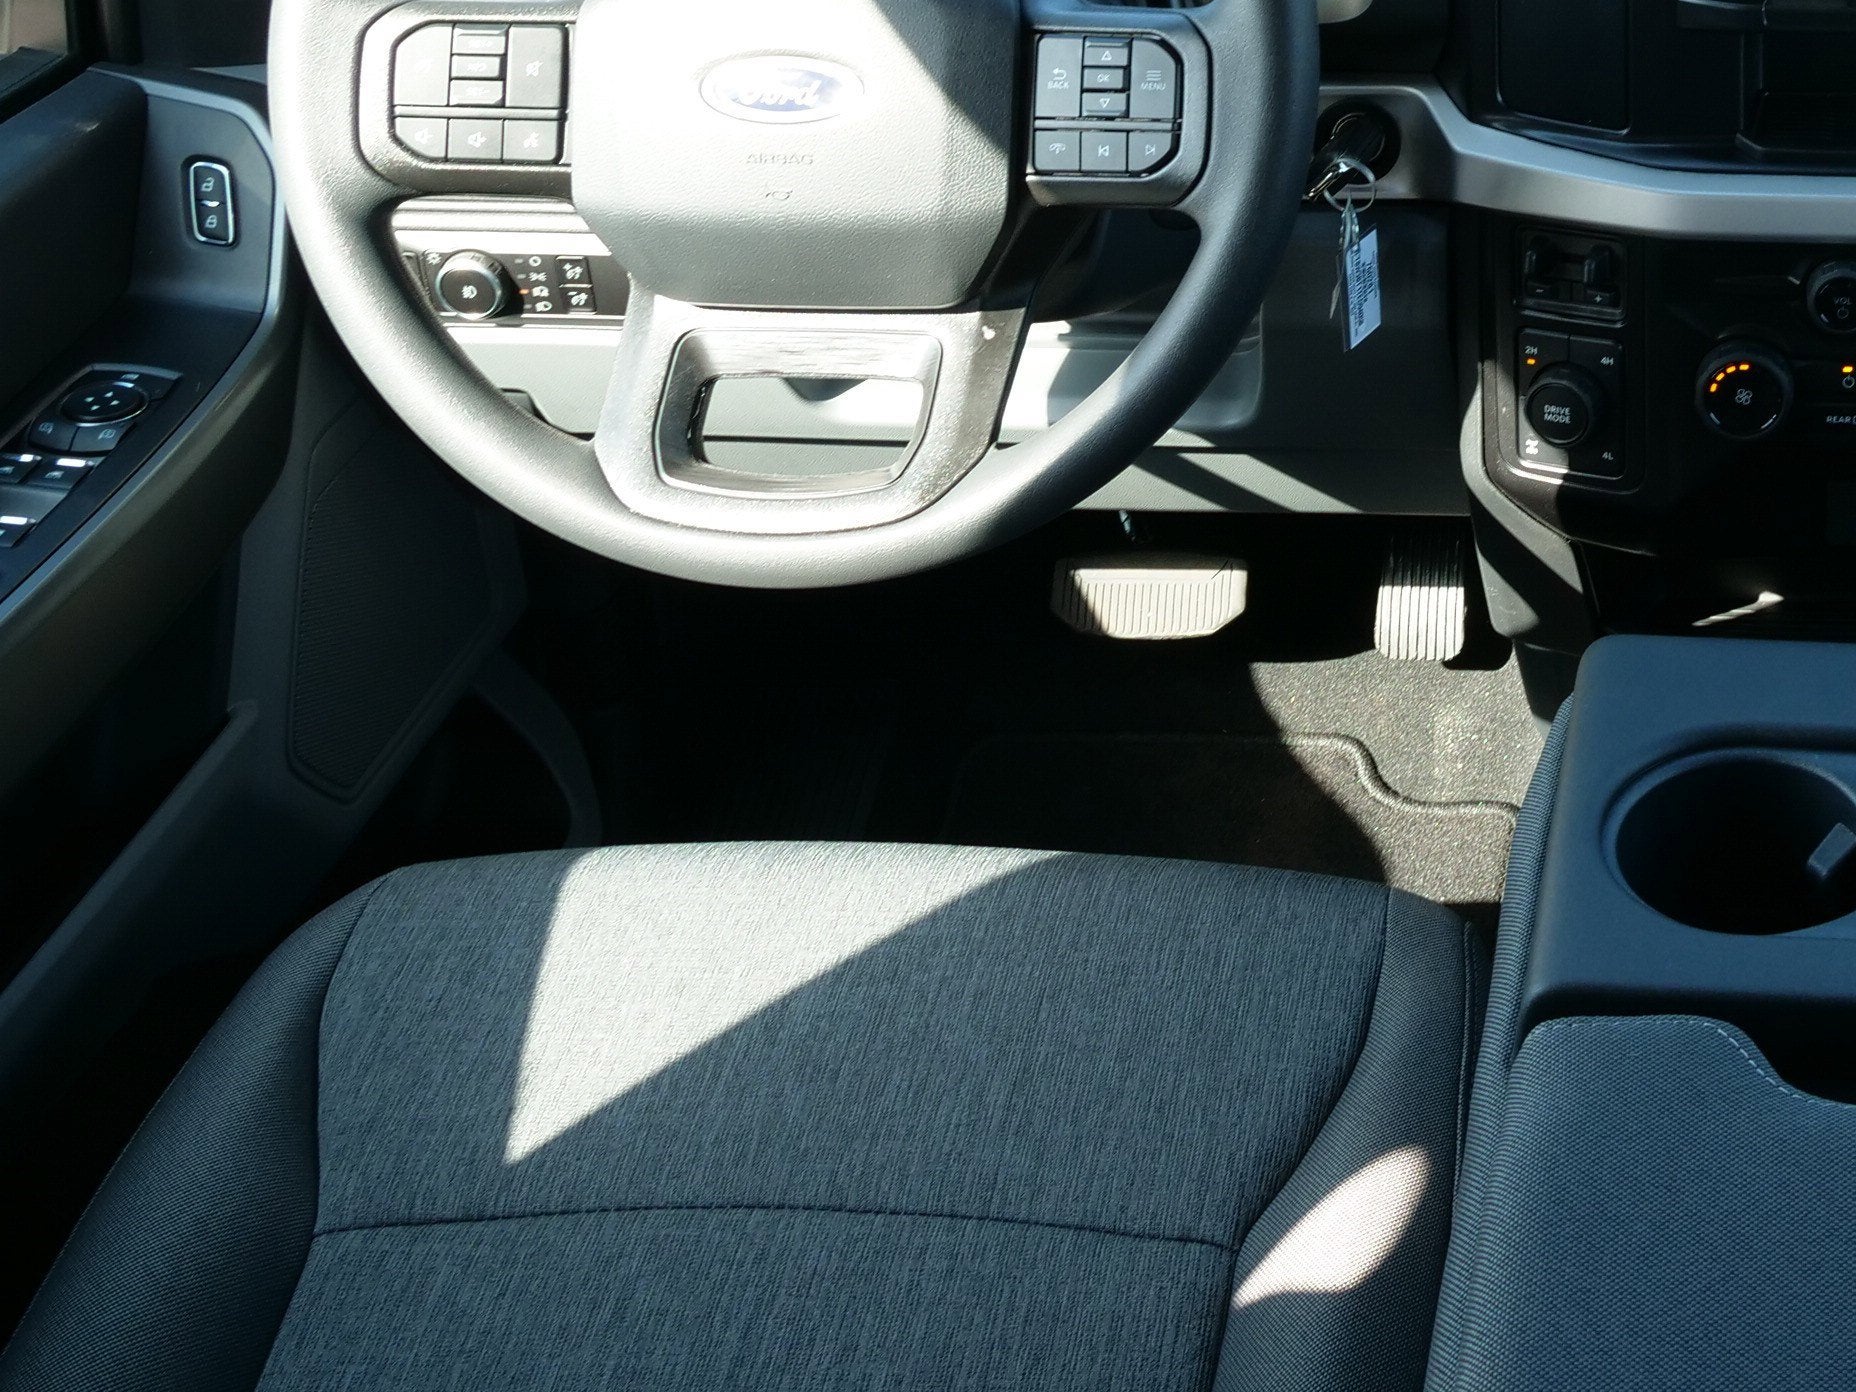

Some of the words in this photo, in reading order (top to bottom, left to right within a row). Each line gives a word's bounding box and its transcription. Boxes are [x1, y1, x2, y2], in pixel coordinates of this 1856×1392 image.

[1046, 80, 1070, 90] BACK
[1140, 82, 1167, 92] MENU
[1833, 296, 1852, 306] VOL
[1525, 345, 1538, 356] 2H
[1600, 356, 1614, 366] 4H
[1544, 404, 1571, 416] DRIVE
[1544, 413, 1571, 424] MODE
[1826, 415, 1852, 424] REAR
[1602, 451, 1614, 461] 4L
